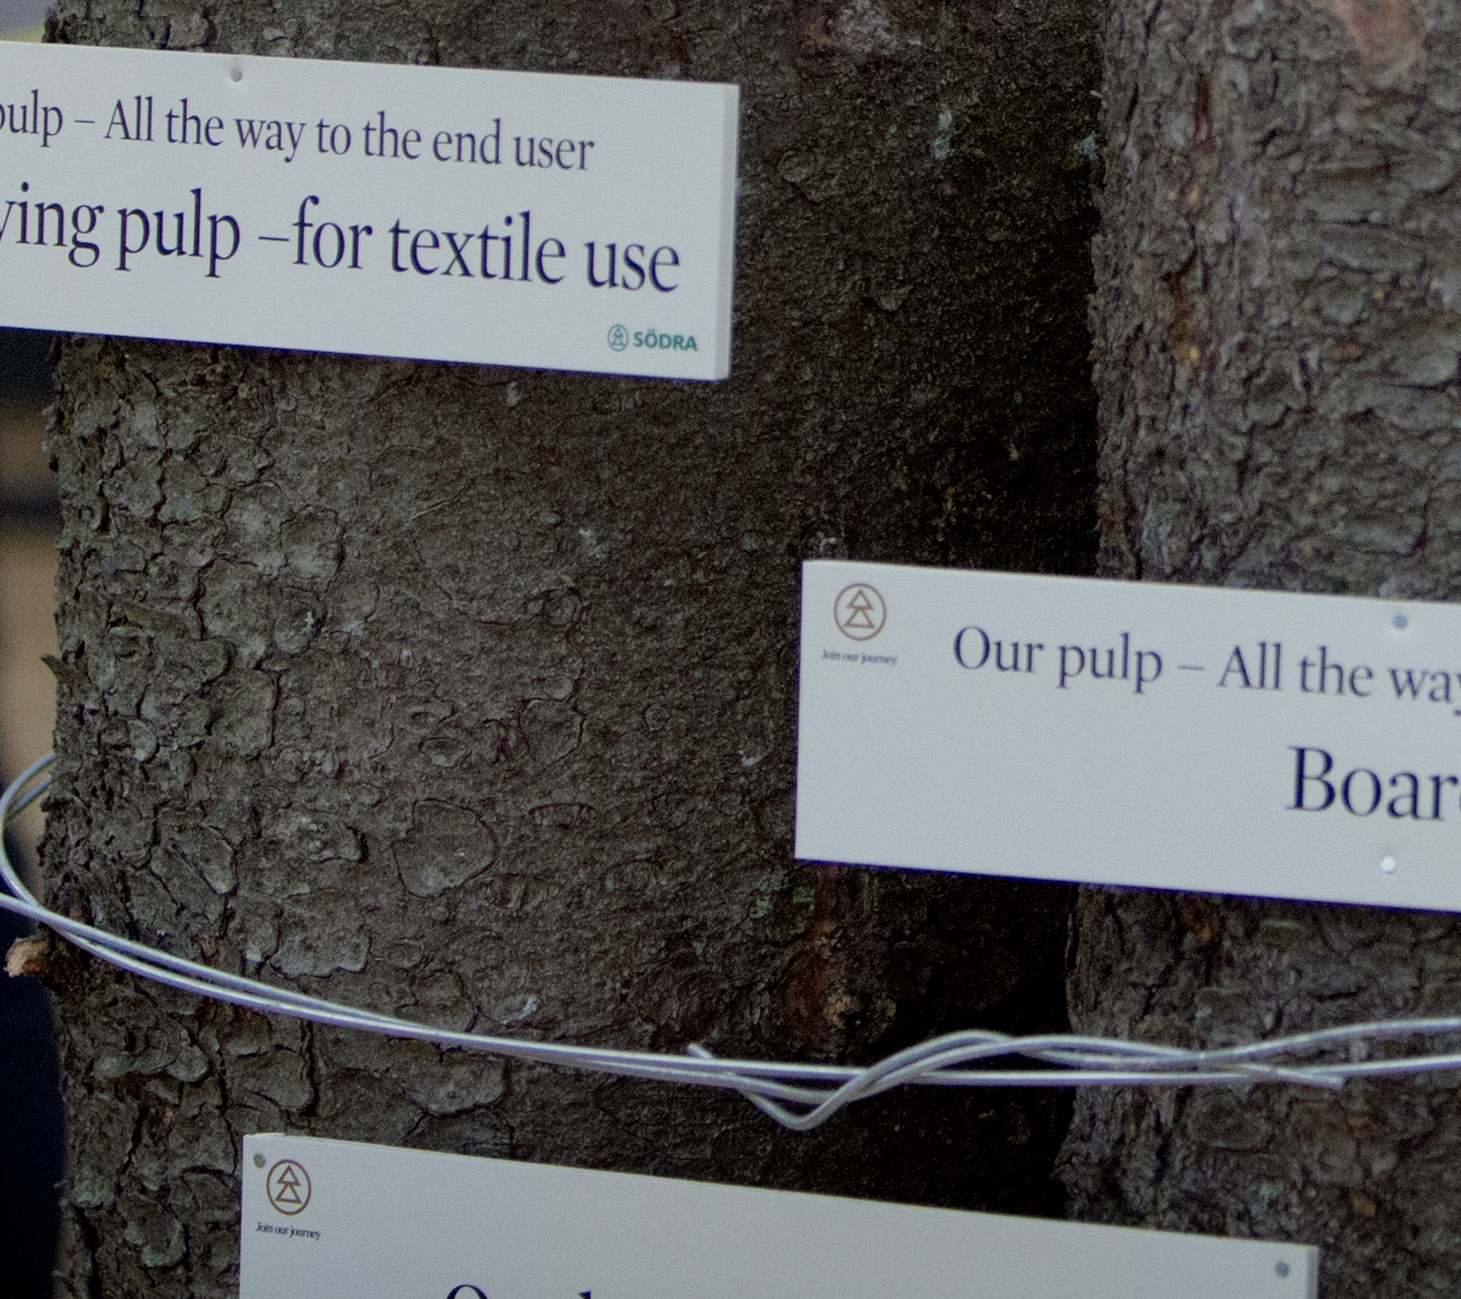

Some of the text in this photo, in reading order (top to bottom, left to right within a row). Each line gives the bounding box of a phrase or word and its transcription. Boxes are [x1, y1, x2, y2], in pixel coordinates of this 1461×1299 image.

[104, 94, 154, 142] All
[165, 97, 225, 147] the
[234, 118, 307, 164] way
[316, 118, 352, 155] to
[362, 109, 422, 161] the
[432, 117, 502, 166] end
[513, 136, 596, 171] user
[116, 187, 241, 279] pulp
[388, 210, 567, 285] textile
[584, 241, 680, 293] use
[633, 328, 699, 352] SÖDRA
[953, 627, 1045, 673] Our
[1058, 631, 1164, 695] pulp
[1218, 640, 1282, 691] All
[1298, 644, 1374, 698] the
[255, 1221, 321, 1241] Join our journey
